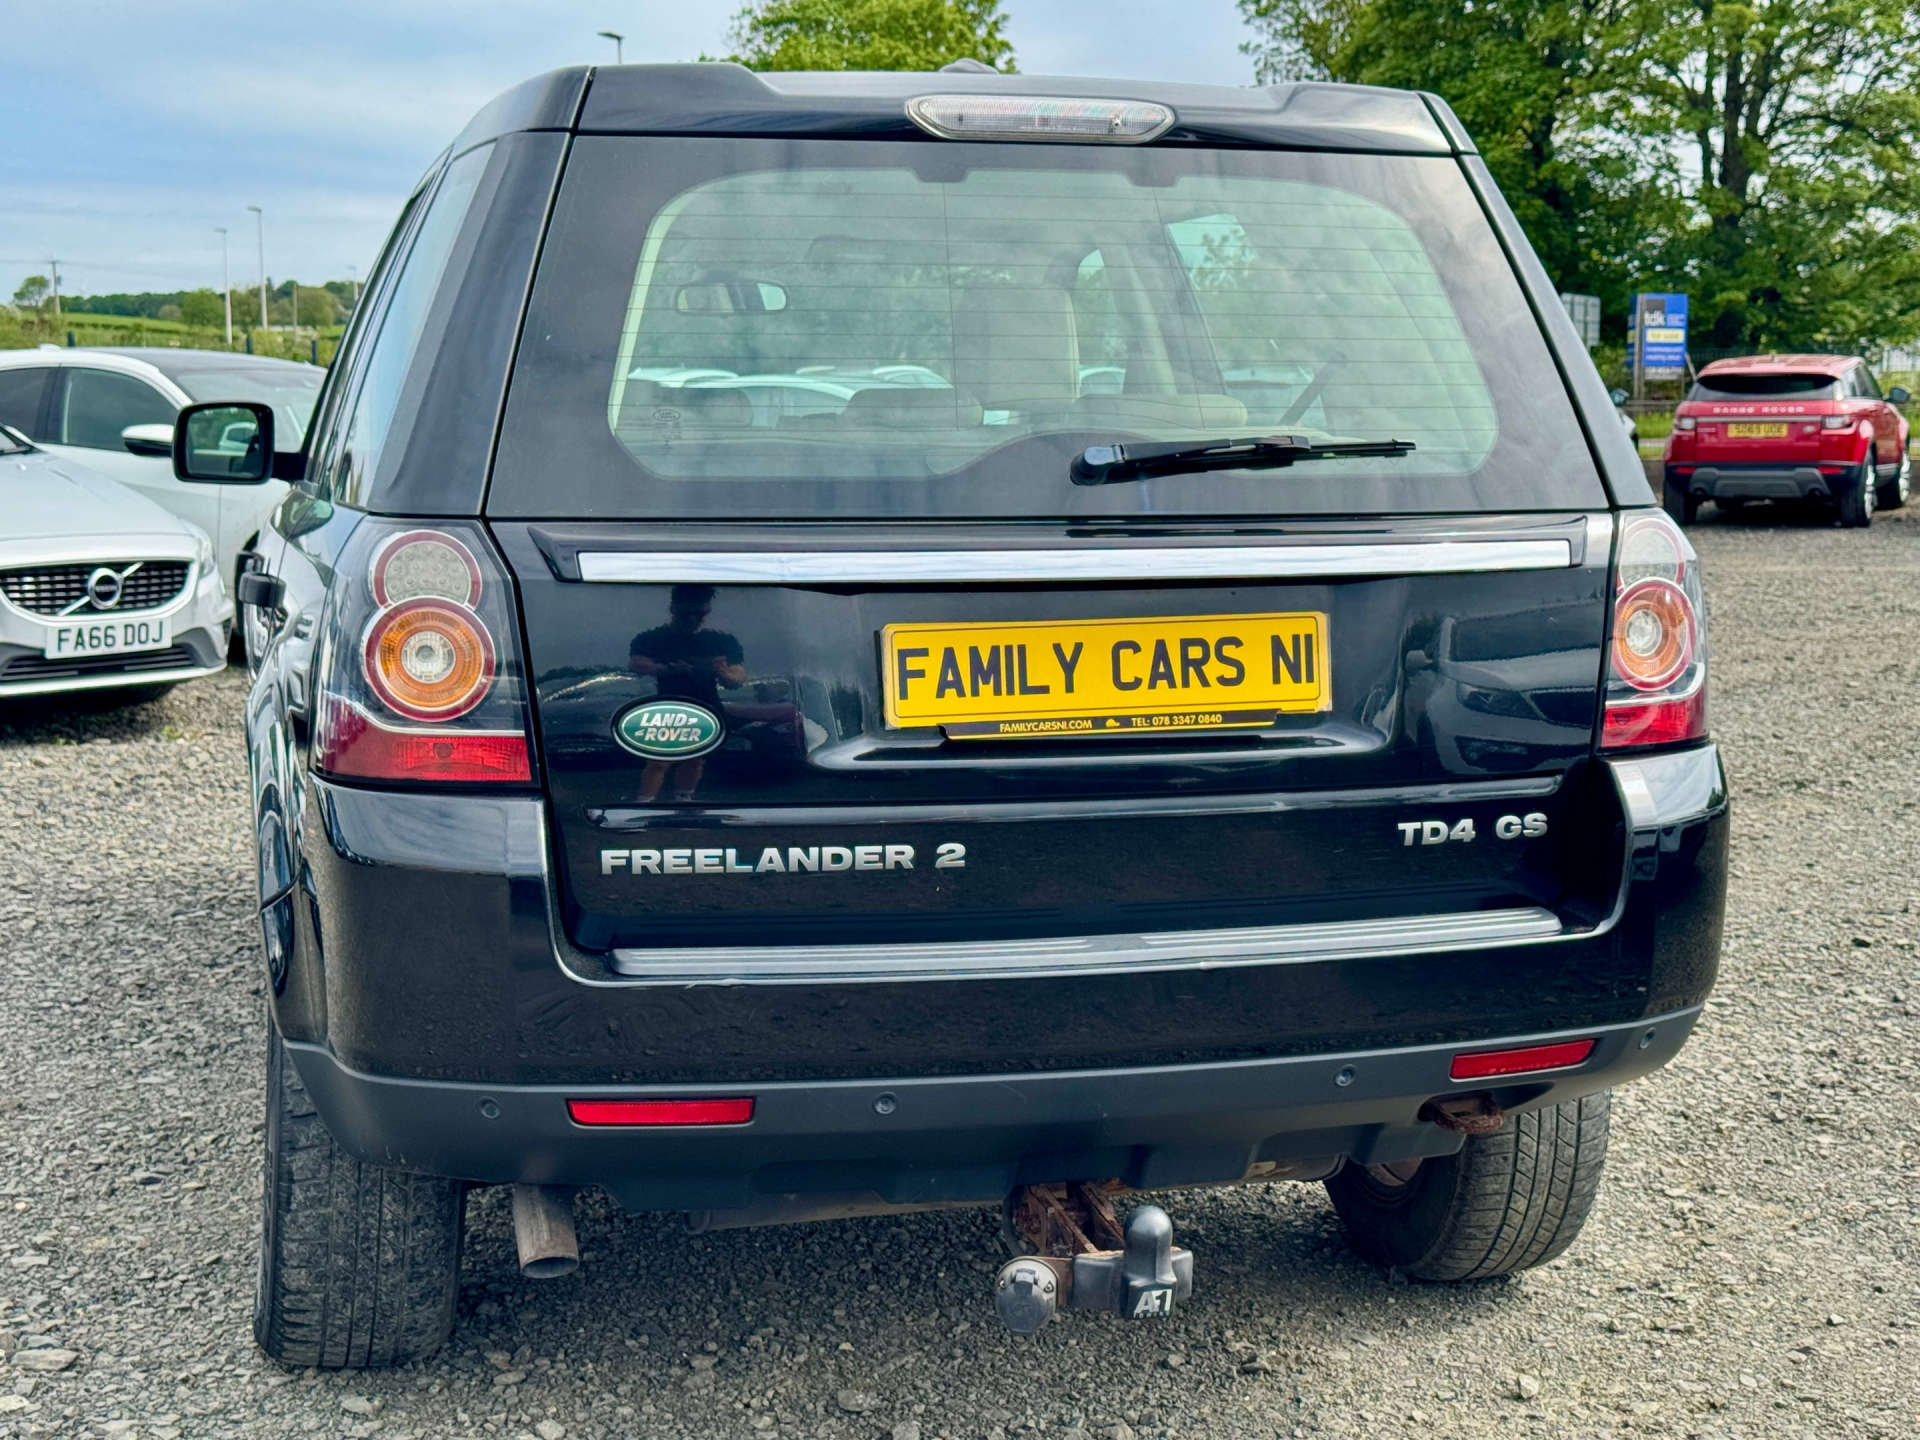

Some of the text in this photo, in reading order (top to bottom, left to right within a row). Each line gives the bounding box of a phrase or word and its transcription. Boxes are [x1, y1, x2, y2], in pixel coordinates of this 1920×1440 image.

[1713, 406, 1805, 414] RANGE ROVER
[57, 621, 164, 652] FA66 DOJ
[897, 633, 1315, 700] FAMILY CARS NI
[640, 712, 688, 727] LAND
[1000, 719, 1093, 733] FAMILYCARSNI.COM
[1152, 716, 1170, 726] 078
[1172, 714, 1196, 725] 3347
[1197, 713, 1223, 724] 0840
[645, 727, 702, 742] ROVER
[1397, 812, 1548, 846] TD4 GS
[601, 842, 966, 875] FREELANDER 2
[1133, 1289, 1172, 1317] A1
